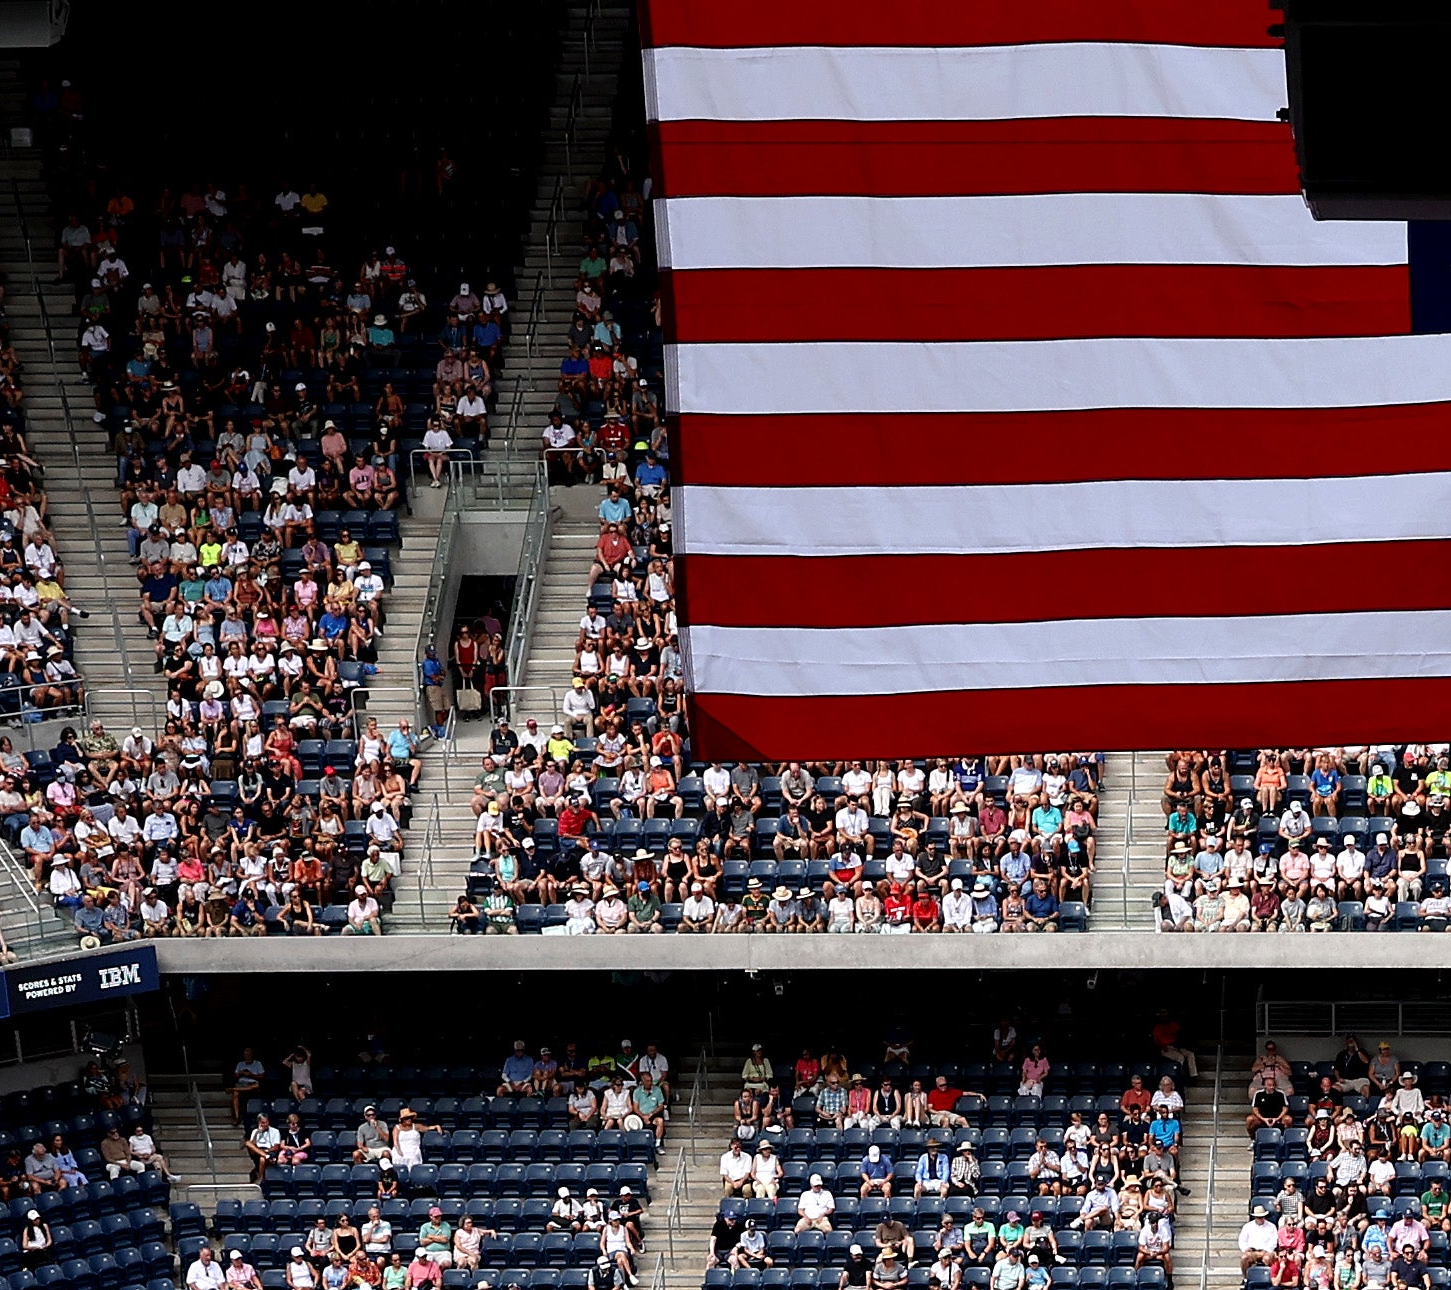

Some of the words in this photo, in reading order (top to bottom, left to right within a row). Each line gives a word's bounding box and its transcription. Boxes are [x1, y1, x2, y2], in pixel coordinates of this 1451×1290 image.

[18, 980, 49, 992] SCORES
[58, 973, 82, 985] STATS
[99, 963, 141, 989] IBM
[25, 986, 64, 1000] POWERED
[64, 983, 79, 994] BY
